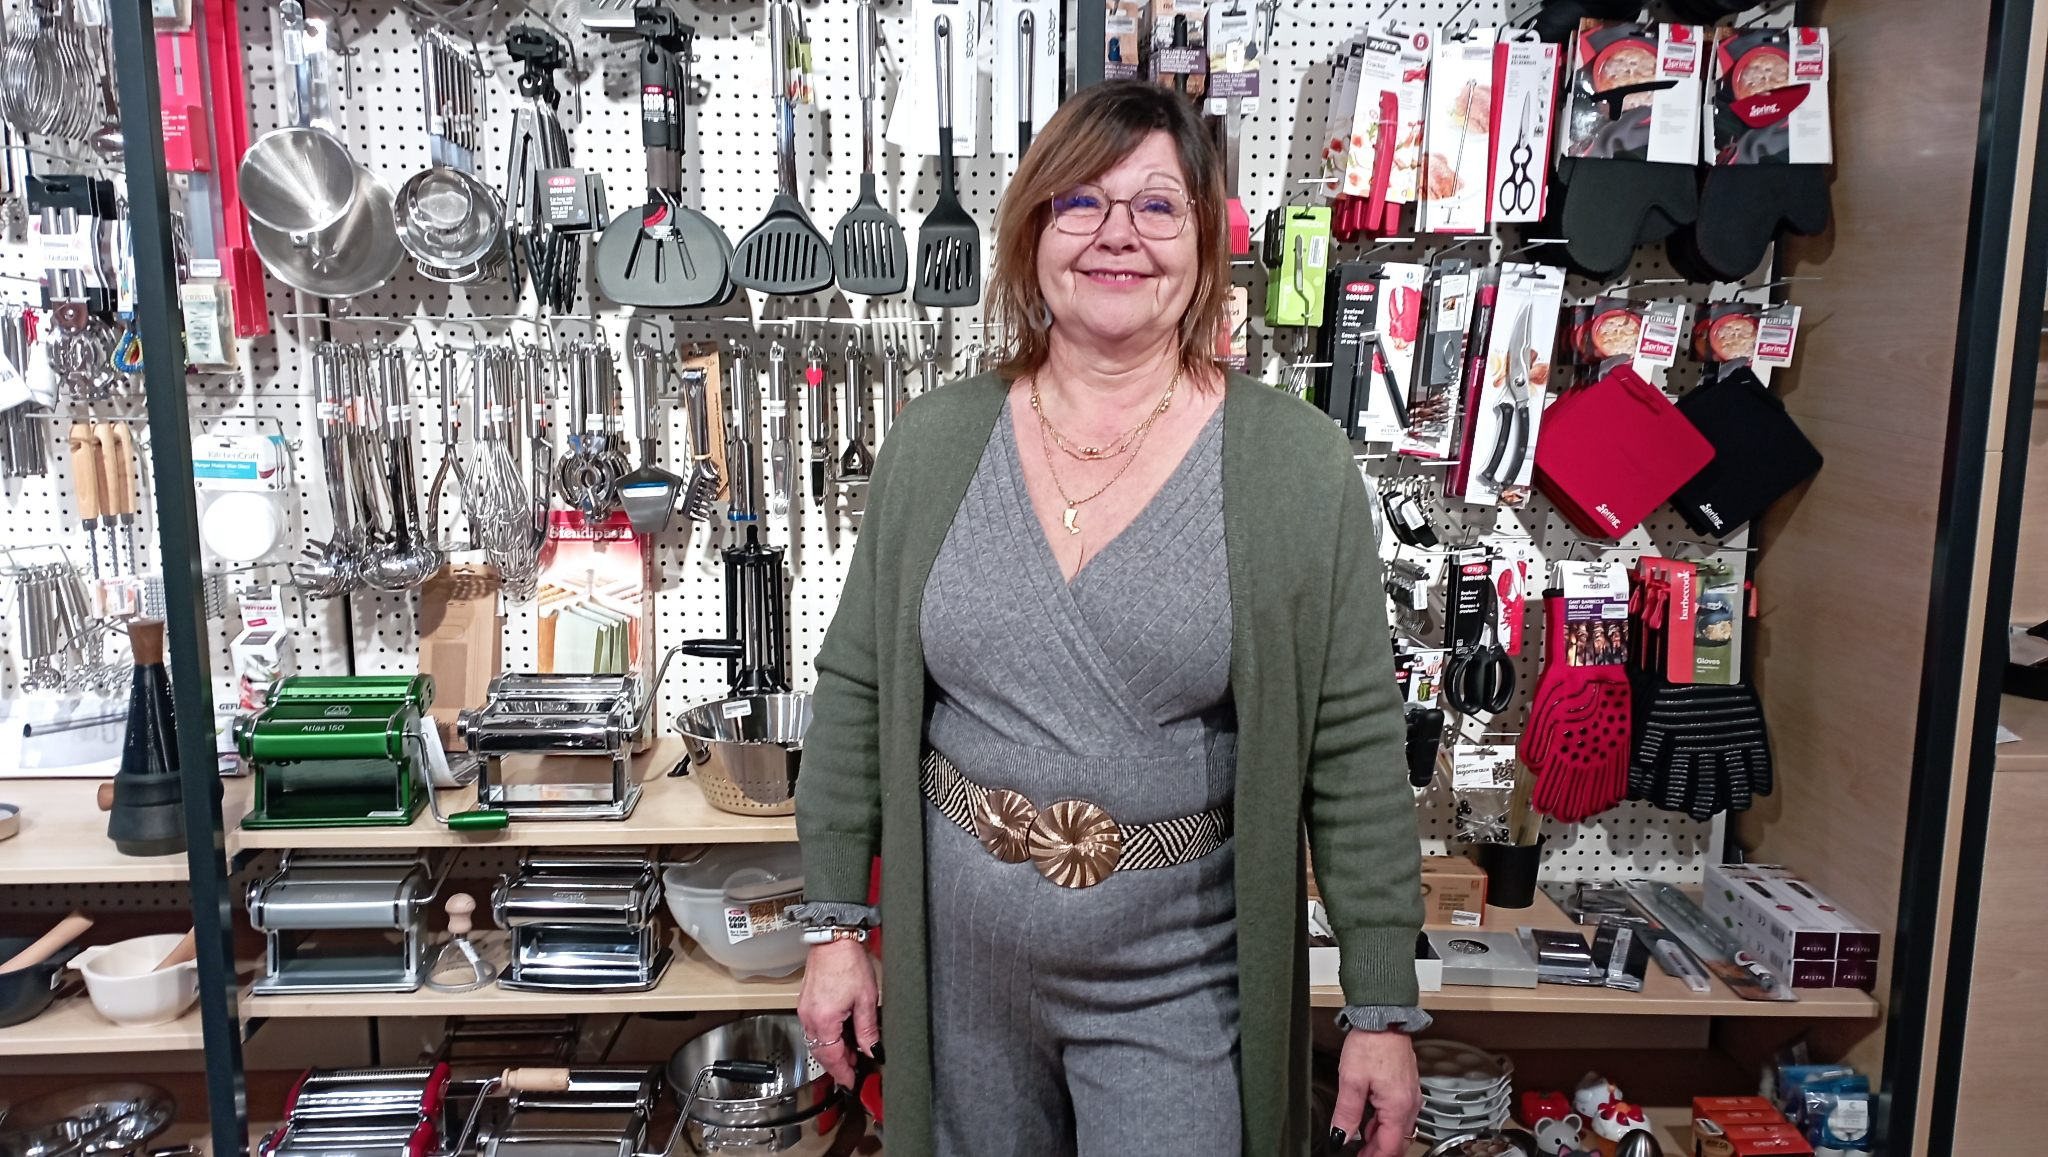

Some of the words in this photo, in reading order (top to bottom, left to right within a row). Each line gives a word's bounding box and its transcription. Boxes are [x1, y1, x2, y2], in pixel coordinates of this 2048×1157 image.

[966, 10, 975, 58] ARCOS
[1047, 8, 1056, 56] ARCOS
[1351, 284, 1370, 292] OXO
[1650, 315, 1675, 325] GRIPS
[1767, 318, 1791, 326] GRIPS
[1677, 569, 1690, 620] barbecook
